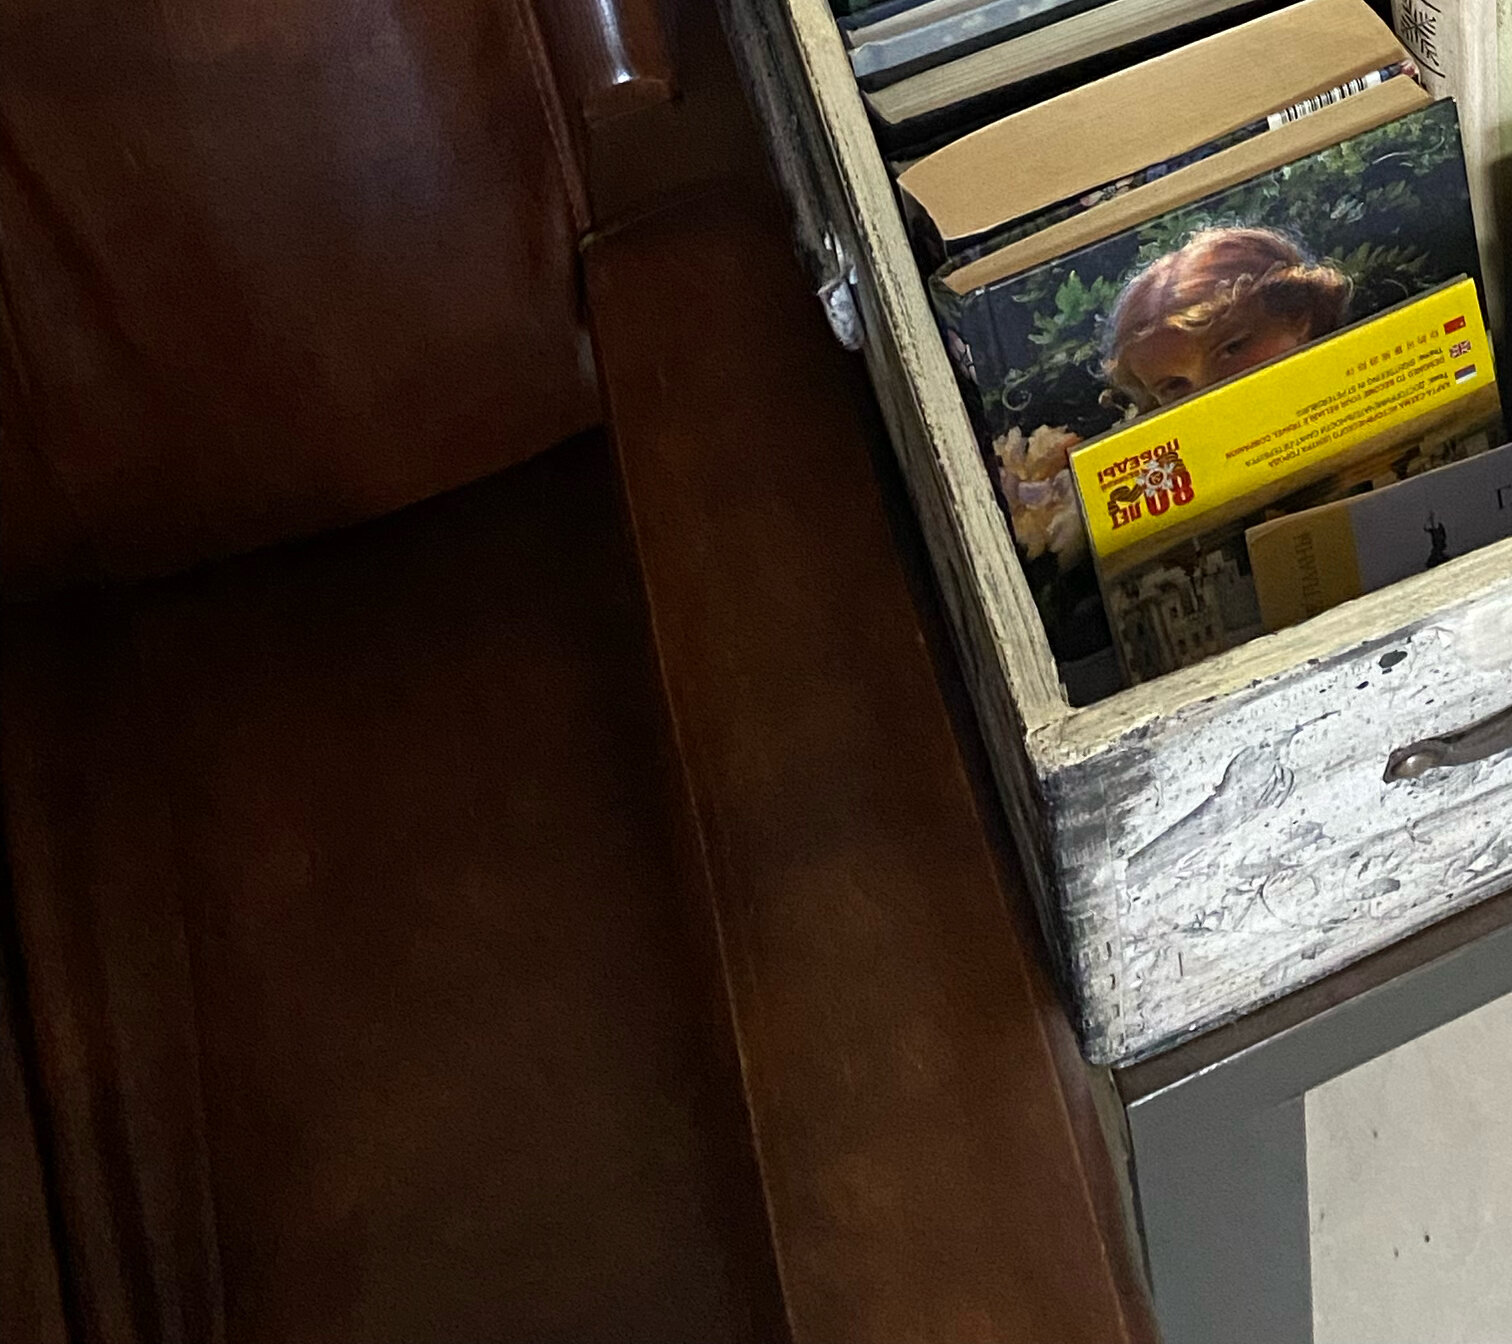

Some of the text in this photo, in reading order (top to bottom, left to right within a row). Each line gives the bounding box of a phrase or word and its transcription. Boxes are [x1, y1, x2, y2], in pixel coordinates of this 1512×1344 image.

[1096, 437, 1181, 484] ПОБЕДЫ
[1109, 470, 1196, 531] ЛЕТ 80
